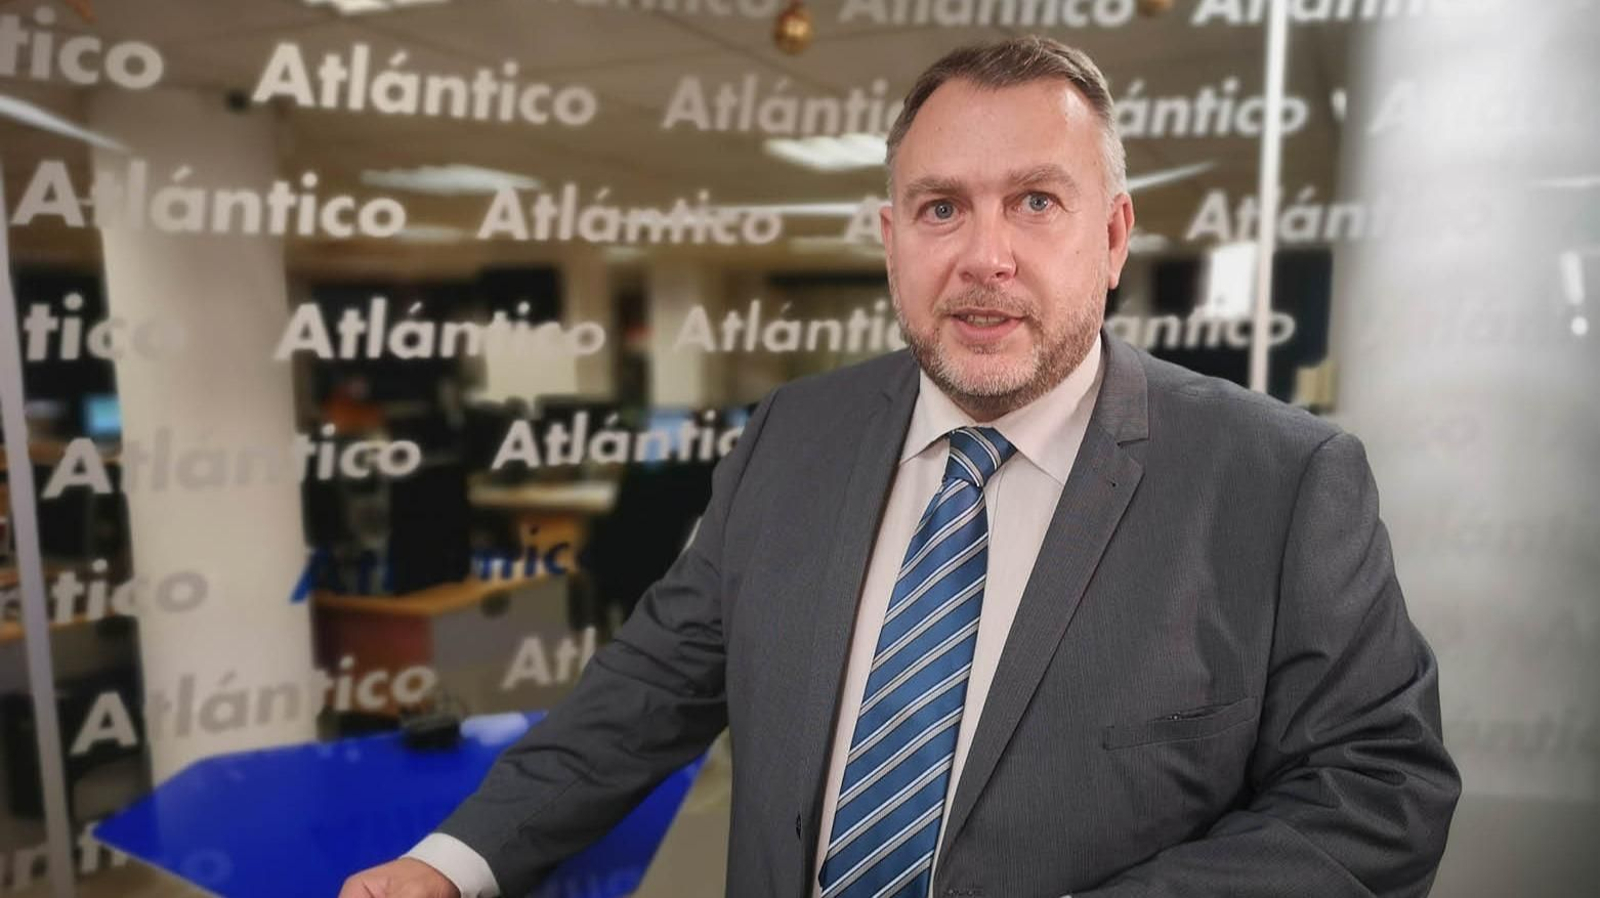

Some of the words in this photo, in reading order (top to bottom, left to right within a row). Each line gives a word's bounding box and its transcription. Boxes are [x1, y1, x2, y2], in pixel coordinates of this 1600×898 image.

[251, 42, 597, 127] Atlántico
[10, 159, 407, 238] Atlántico
[477, 182, 783, 244] Atlántico
[272, 297, 607, 361] Atlántico
[42, 422, 422, 498] Atlántico
[70, 655, 436, 756] Atlántico
